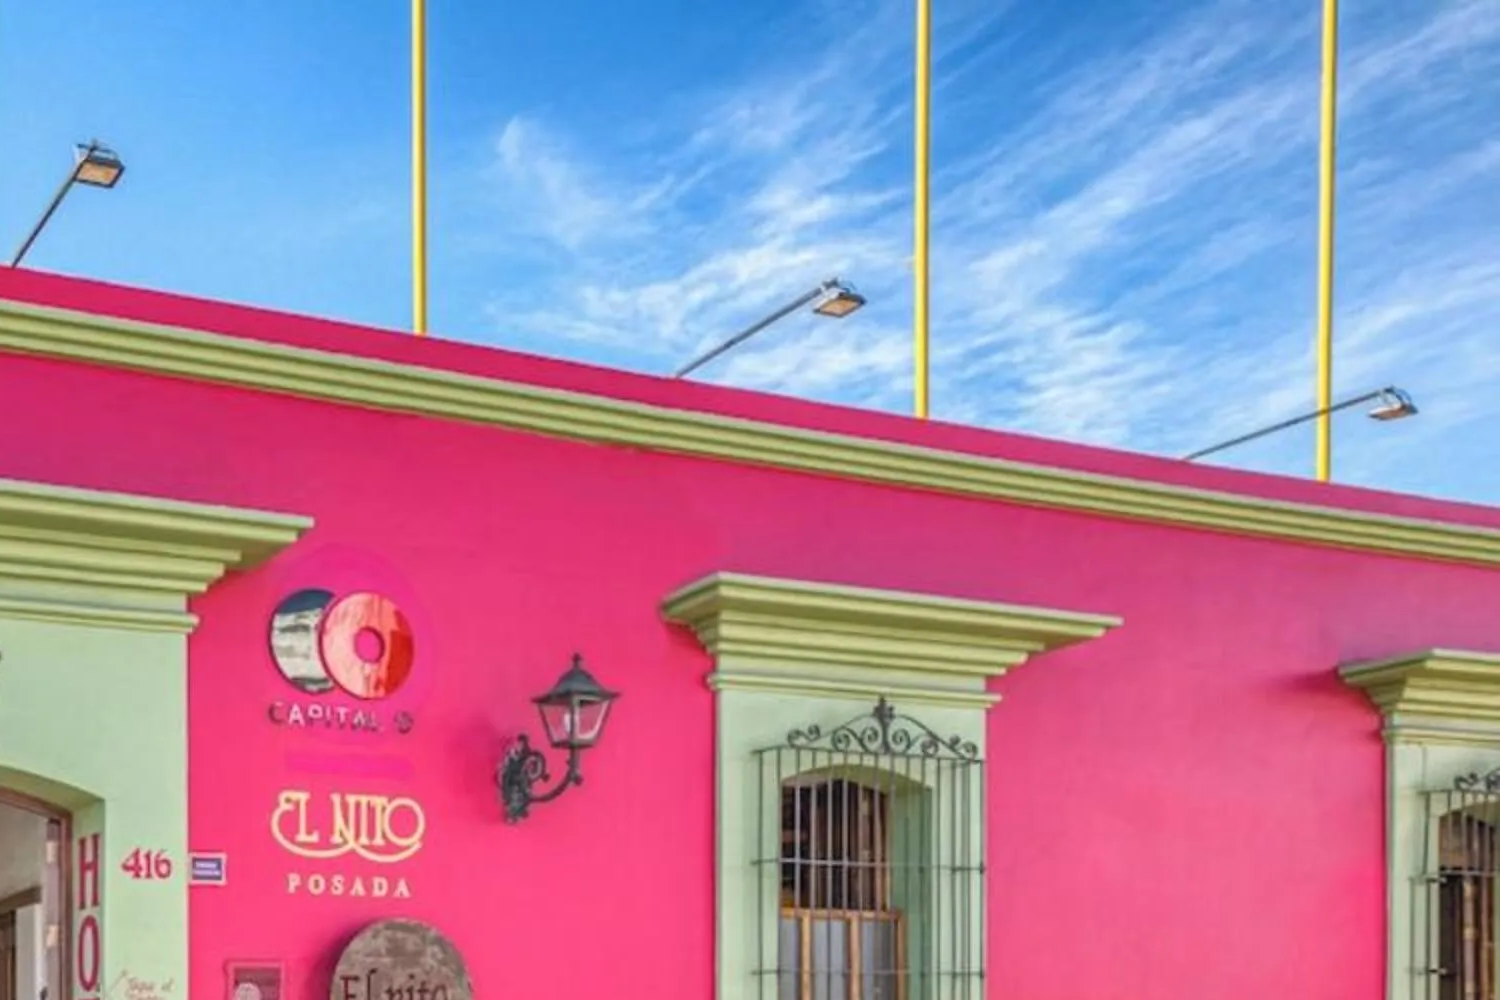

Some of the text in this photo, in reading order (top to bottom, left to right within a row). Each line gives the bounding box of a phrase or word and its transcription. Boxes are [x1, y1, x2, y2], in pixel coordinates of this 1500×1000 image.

[268, 702, 381, 733] CAPITAL
[271, 789, 425, 863] EL NITO
[120, 847, 172, 880] 416
[286, 872, 411, 898] POSADA
